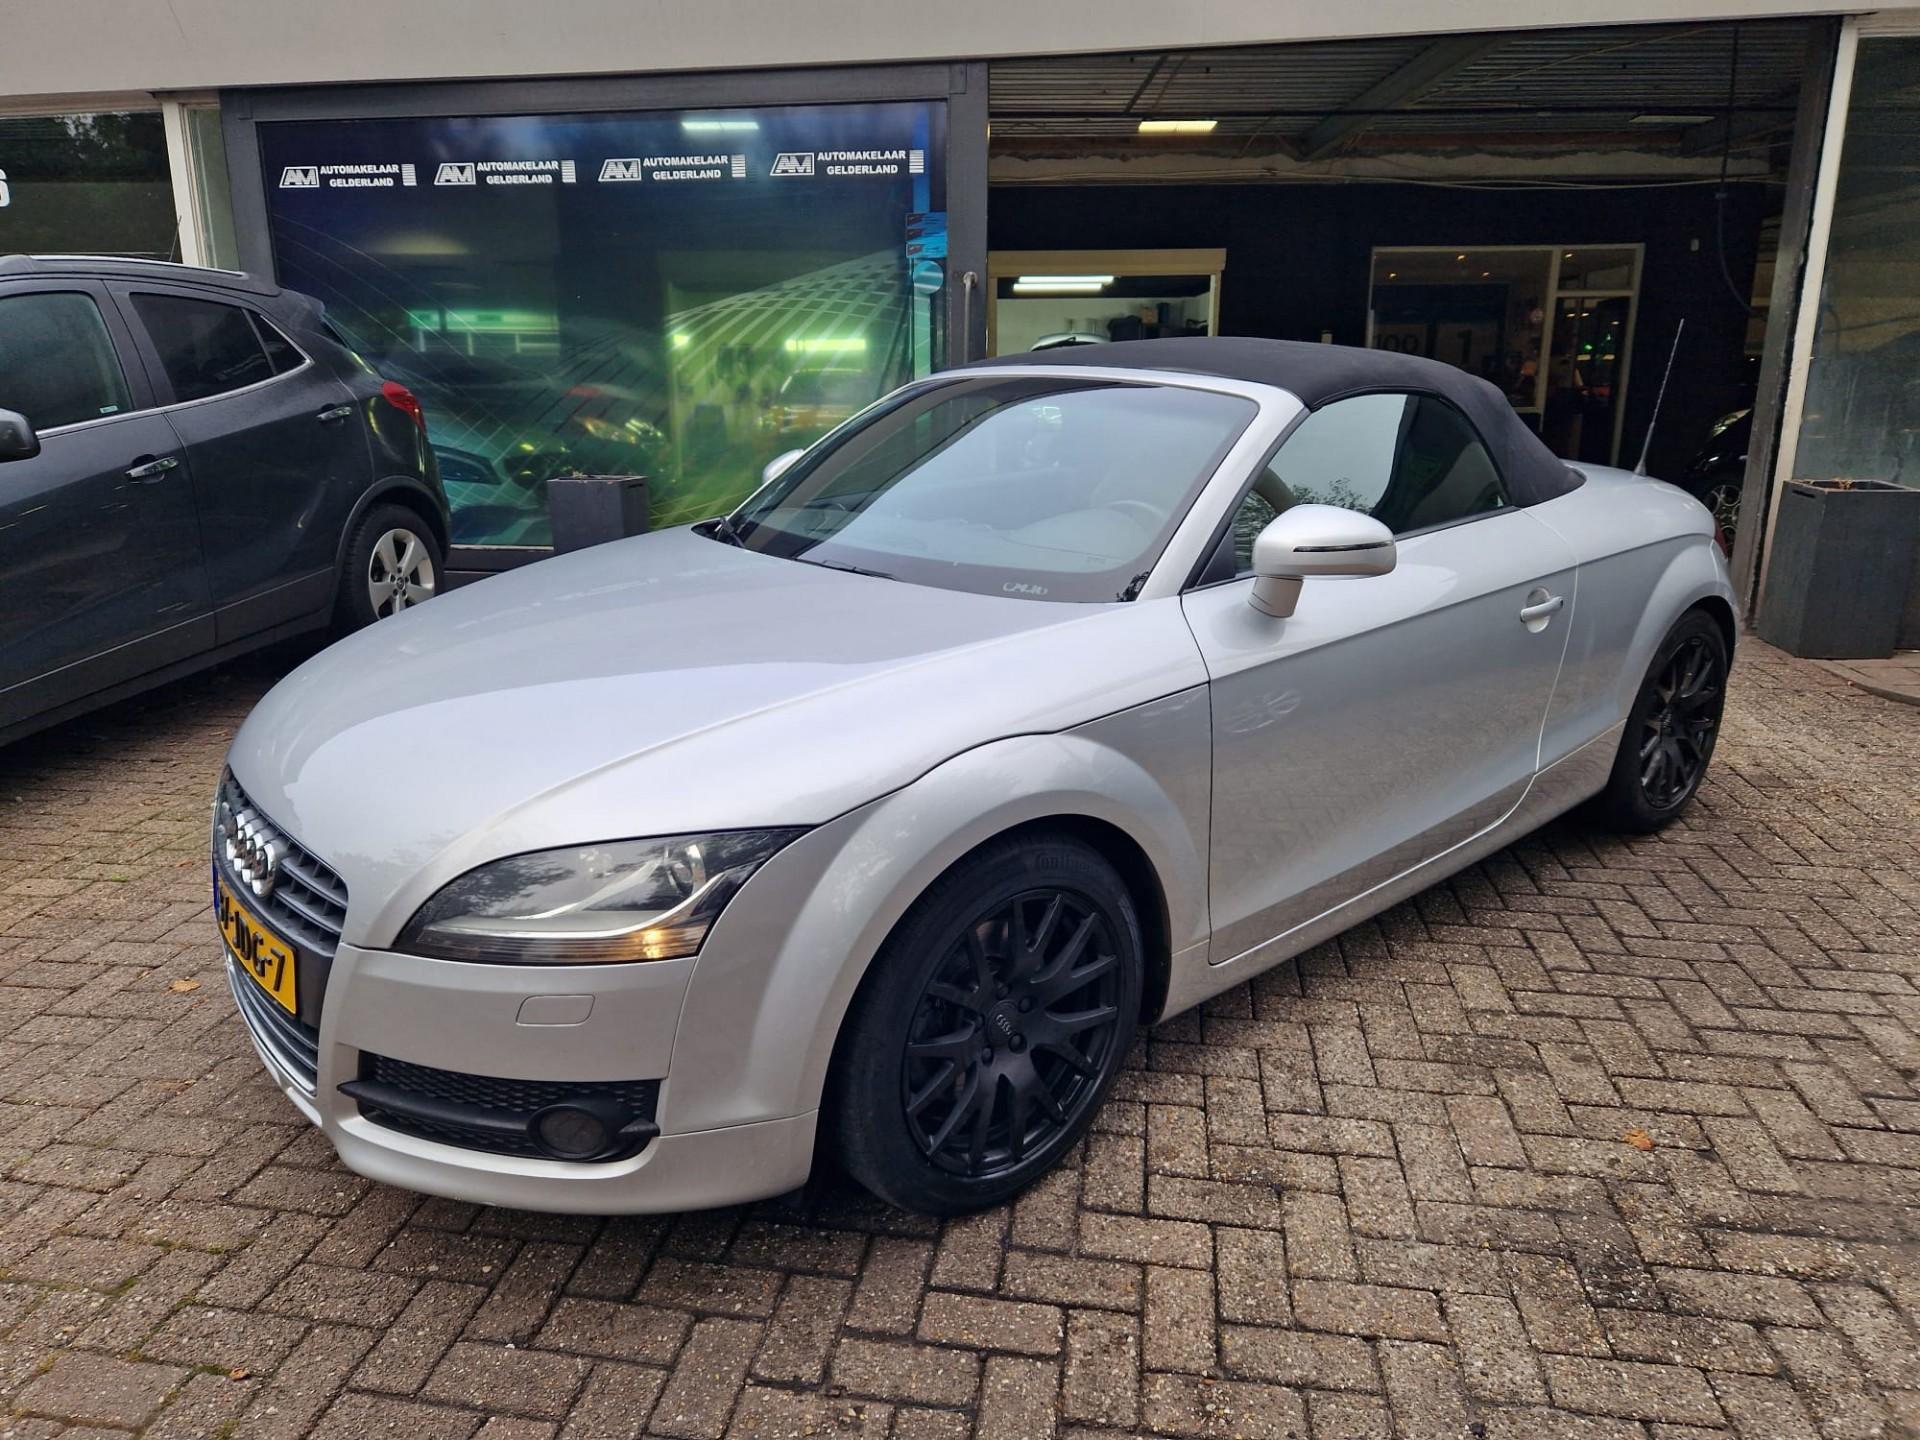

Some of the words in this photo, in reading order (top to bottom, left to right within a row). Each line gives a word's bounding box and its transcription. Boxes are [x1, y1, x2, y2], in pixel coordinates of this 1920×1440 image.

[643, 155, 728, 167] AUTOMAKELAAR
[817, 150, 906, 161] AUTOMAKELAAR
[320, 164, 399, 175] AUTOMAKELAAR
[477, 161, 559, 172] AUTOMAKELAAR
[603, 160, 638, 180] AM
[775, 154, 812, 174] AM
[827, 164, 898, 176] GELDERLAND
[283, 168, 317, 186] AM
[440, 165, 474, 184] AM
[486, 175, 553, 185] GELDERLAND
[652, 169, 721, 181] GELDERLAND
[329, 178, 394, 188] GELDERLAND
